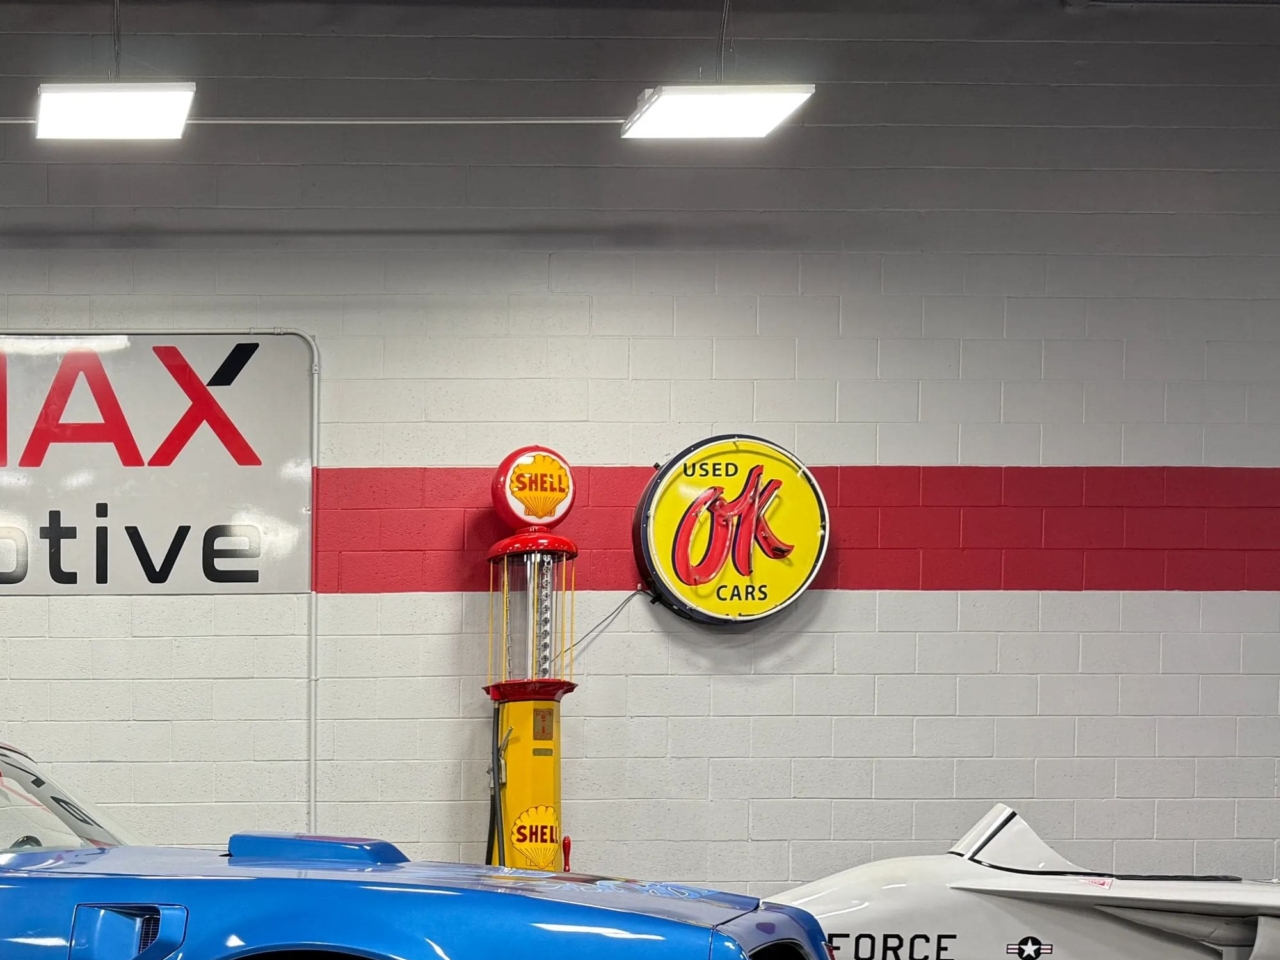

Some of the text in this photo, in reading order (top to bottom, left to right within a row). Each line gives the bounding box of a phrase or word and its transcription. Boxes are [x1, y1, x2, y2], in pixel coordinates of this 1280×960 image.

[683, 462, 738, 478] USED
[516, 472, 566, 494] SHELL
[672, 465, 795, 586] OK
[716, 585, 768, 602] CARS
